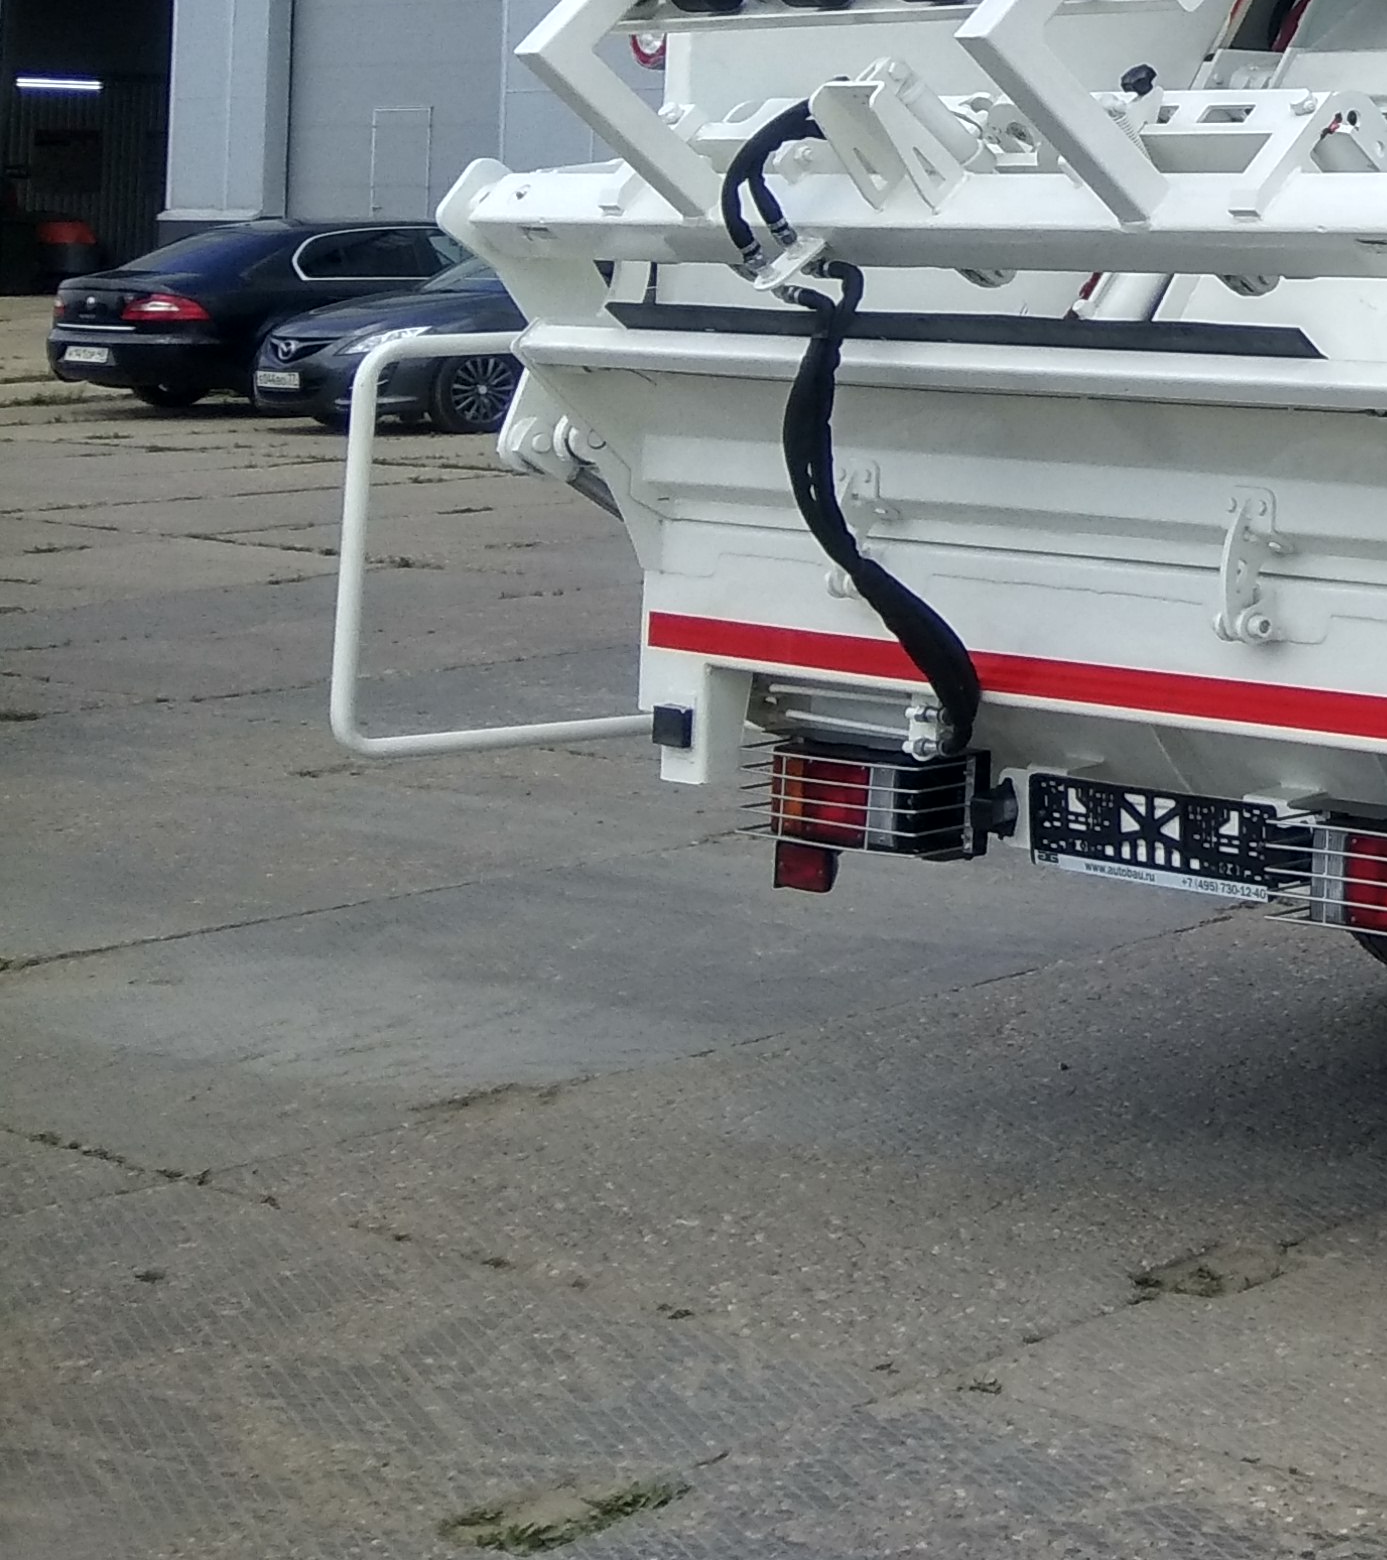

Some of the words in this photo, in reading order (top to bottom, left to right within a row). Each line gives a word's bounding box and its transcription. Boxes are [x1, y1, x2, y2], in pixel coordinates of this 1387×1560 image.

[1084, 862, 1155, 882] www.autobau.ru
[1182, 877, 1193, 888] +7
[1194, 879, 1218, 893] (495)
